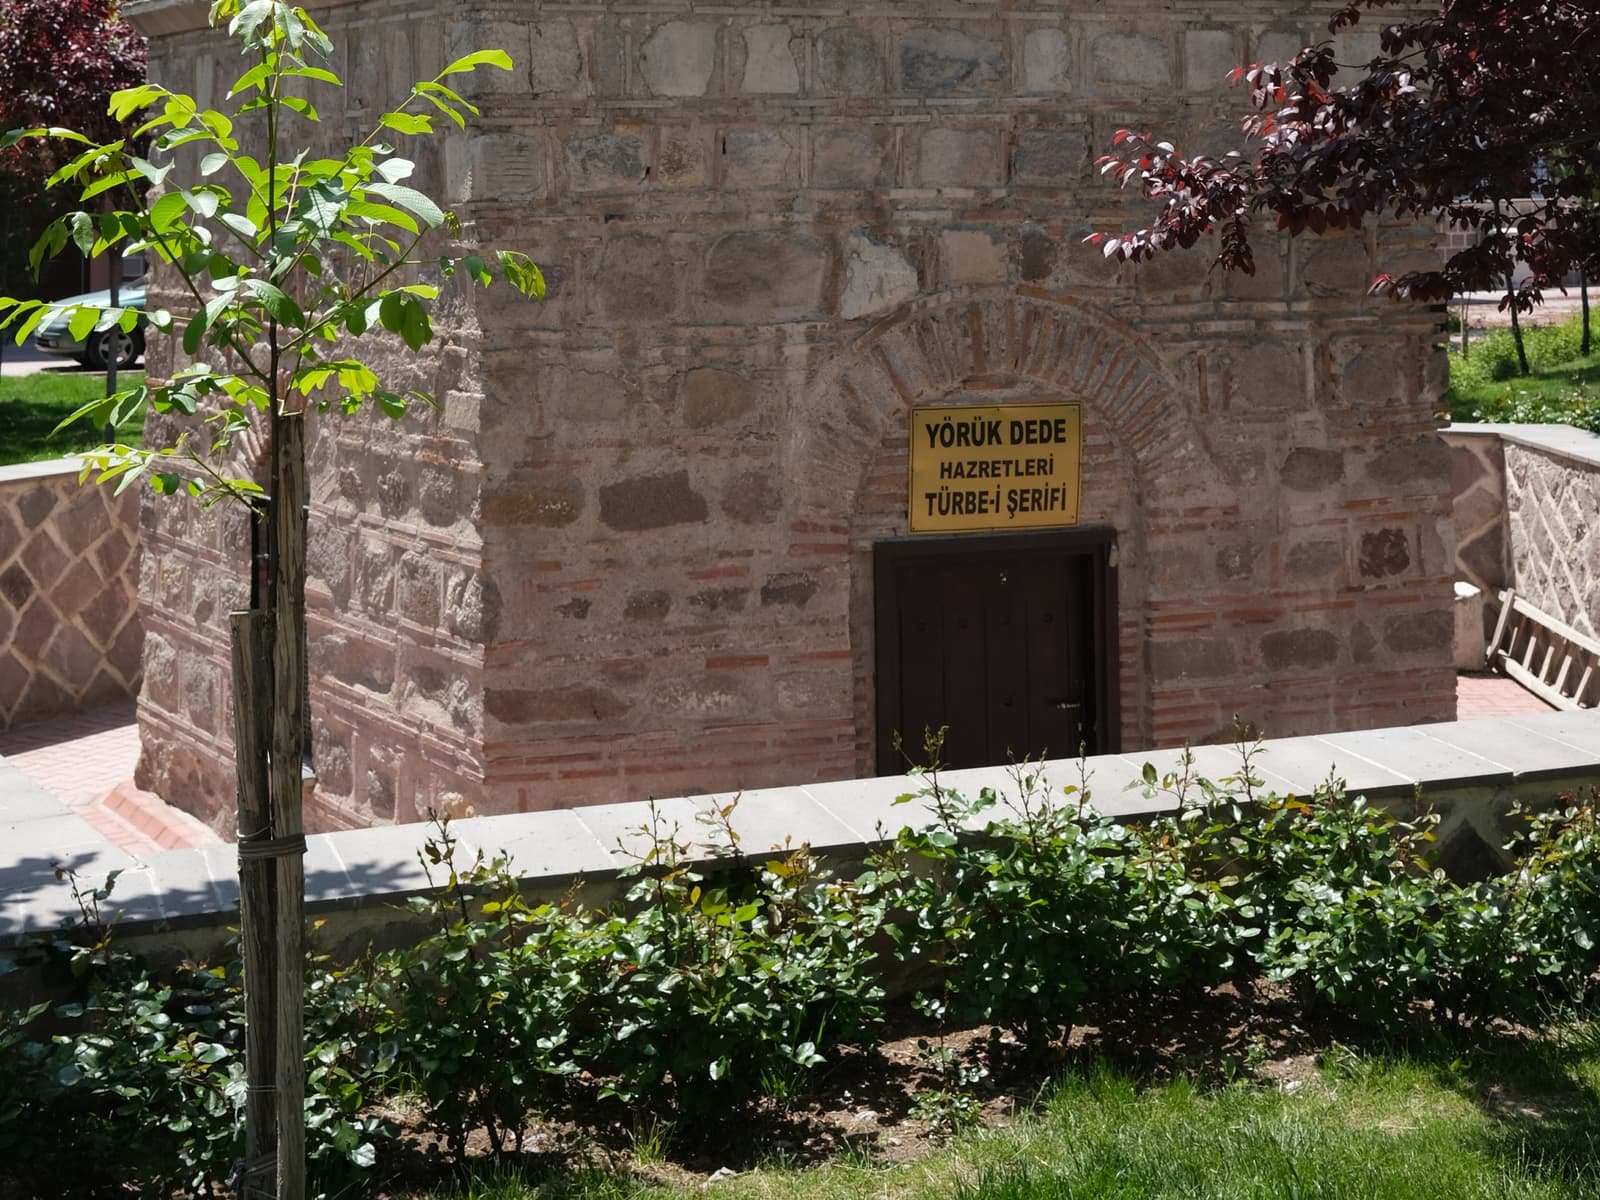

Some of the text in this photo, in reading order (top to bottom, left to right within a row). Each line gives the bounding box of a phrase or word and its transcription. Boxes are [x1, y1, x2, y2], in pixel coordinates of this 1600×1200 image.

[925, 416, 1066, 448] YÖRÜK DEDE
[940, 453, 1053, 479] HAZRETLERİ
[925, 482, 1066, 519] TÜRBE-İ ŞERİFİ
